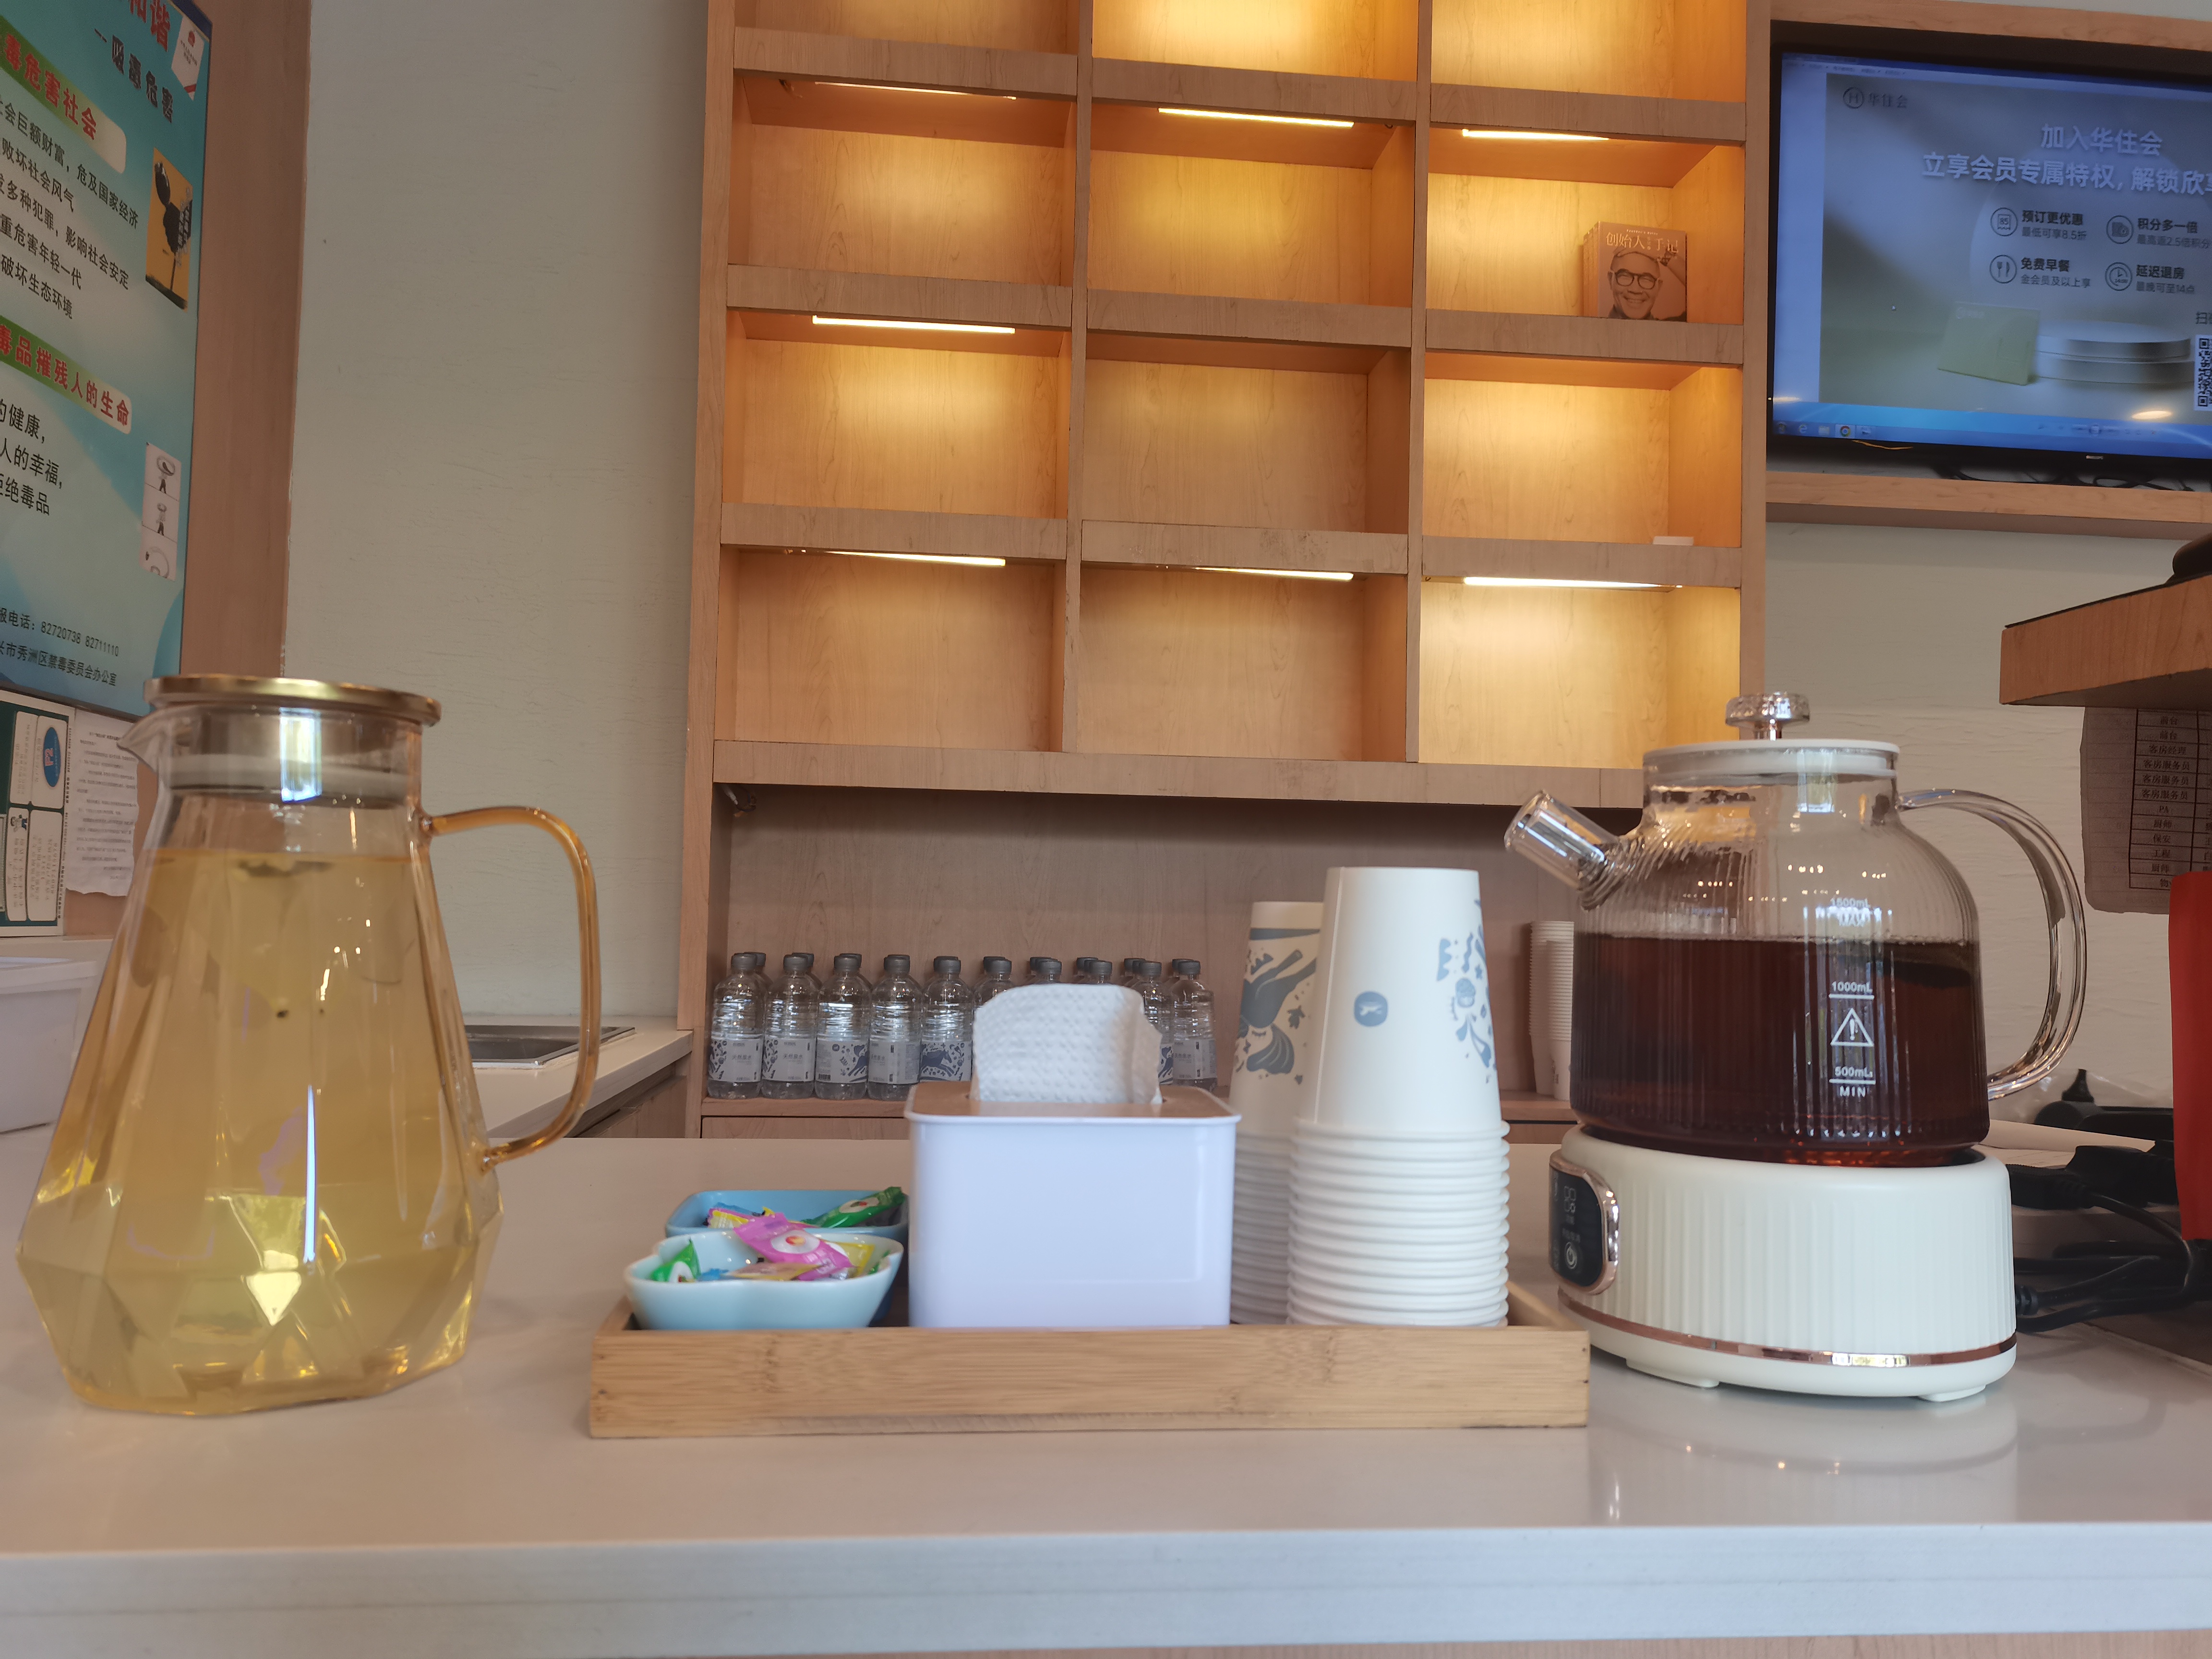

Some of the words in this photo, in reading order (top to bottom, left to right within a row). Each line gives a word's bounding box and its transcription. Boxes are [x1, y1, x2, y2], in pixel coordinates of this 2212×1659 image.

[2041, 123, 2163, 156] 加入华住会
[2022, 210, 2083, 226] 预订更优惠
[2138, 217, 2198, 234] 积分多一倍
[2020, 257, 2069, 273] 免费早餐
[2136, 264, 2185, 280] 延迟退房
[1, 254, 72, 319] 破坏生态环境
[2020, 274, 2091, 288] 金会员及以上享
[0, 324, 129, 426] 毒品摧残人的生命
[41, 621, 81, 644] 82720738
[85, 636, 119, 657] 82711110
[2143, 759, 2190, 770] 客房服务员
[2142, 774, 2189, 785] 客房服务员
[2141, 789, 2188, 800] 客房服务员
[2153, 834, 2171, 844] 保安
[2160, 878, 2171, 888] 物
[1831, 982, 1873, 993] 1000mL
[1834, 1067, 1873, 1078] 500mL
[1839, 1086, 1866, 1097] MIN
